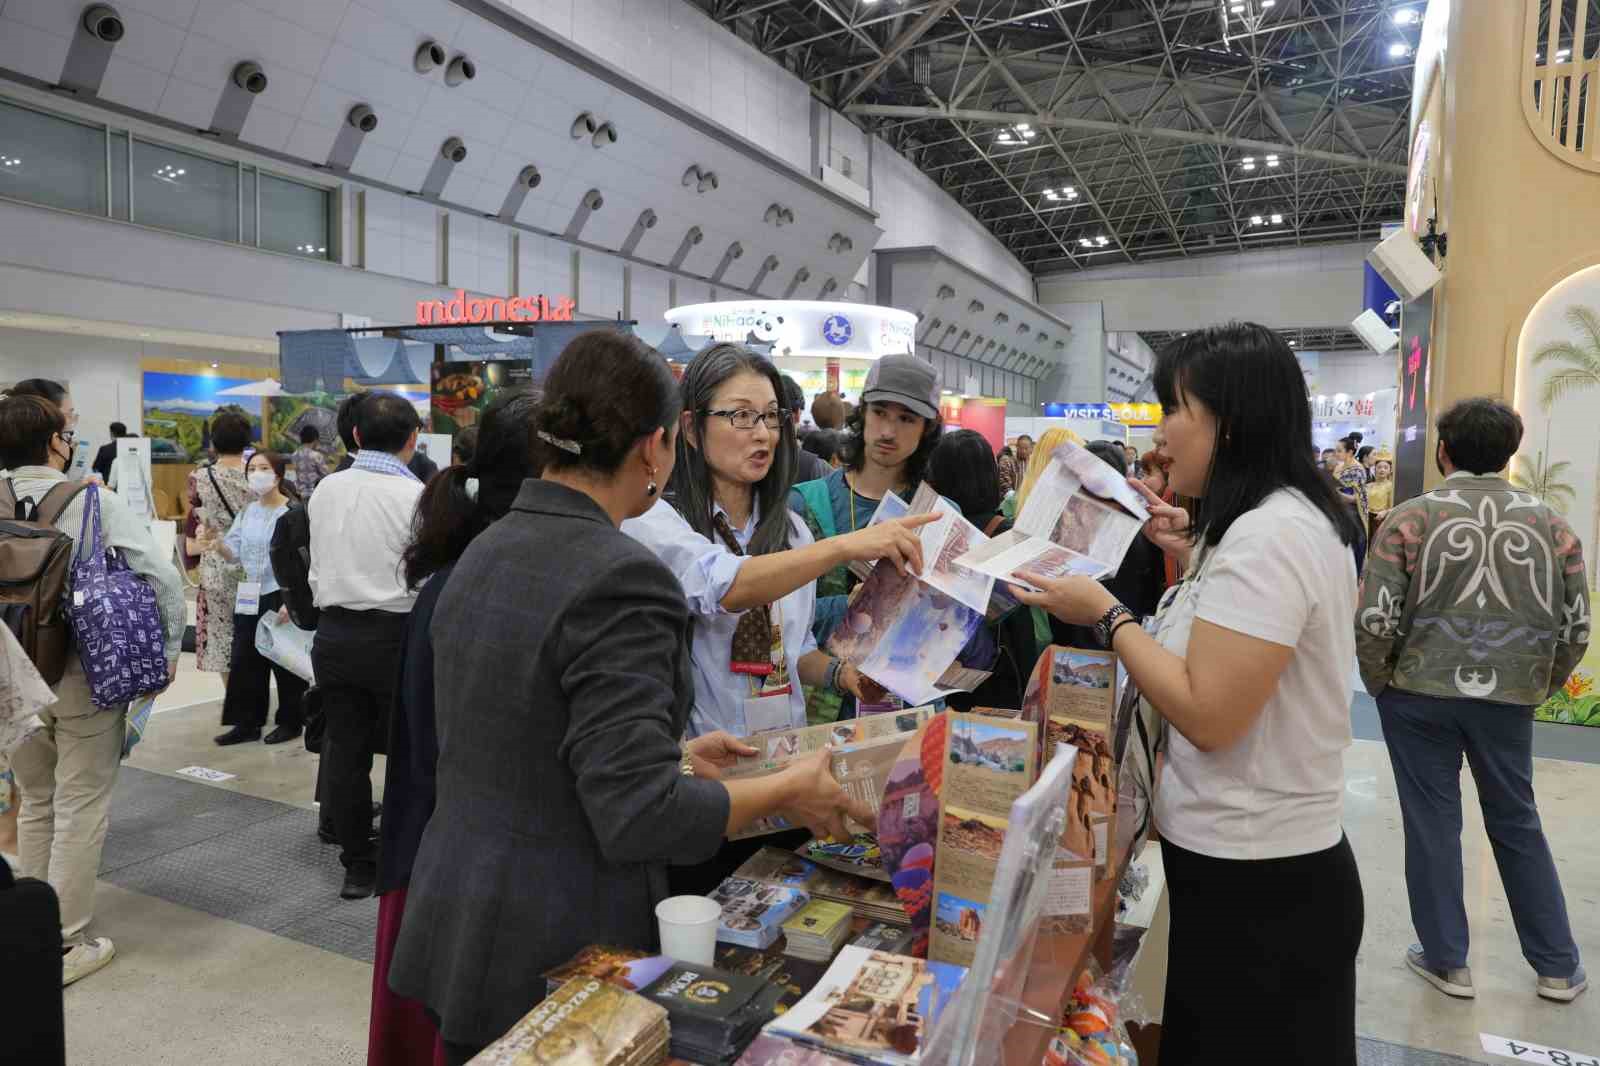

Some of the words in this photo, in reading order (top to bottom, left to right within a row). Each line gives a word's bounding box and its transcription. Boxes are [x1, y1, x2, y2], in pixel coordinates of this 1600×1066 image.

[1064, 408, 1100, 420] VISIT
[1102, 408, 1153, 421] SEOUL
[1506, 1041, 1600, 1066] 8-4
